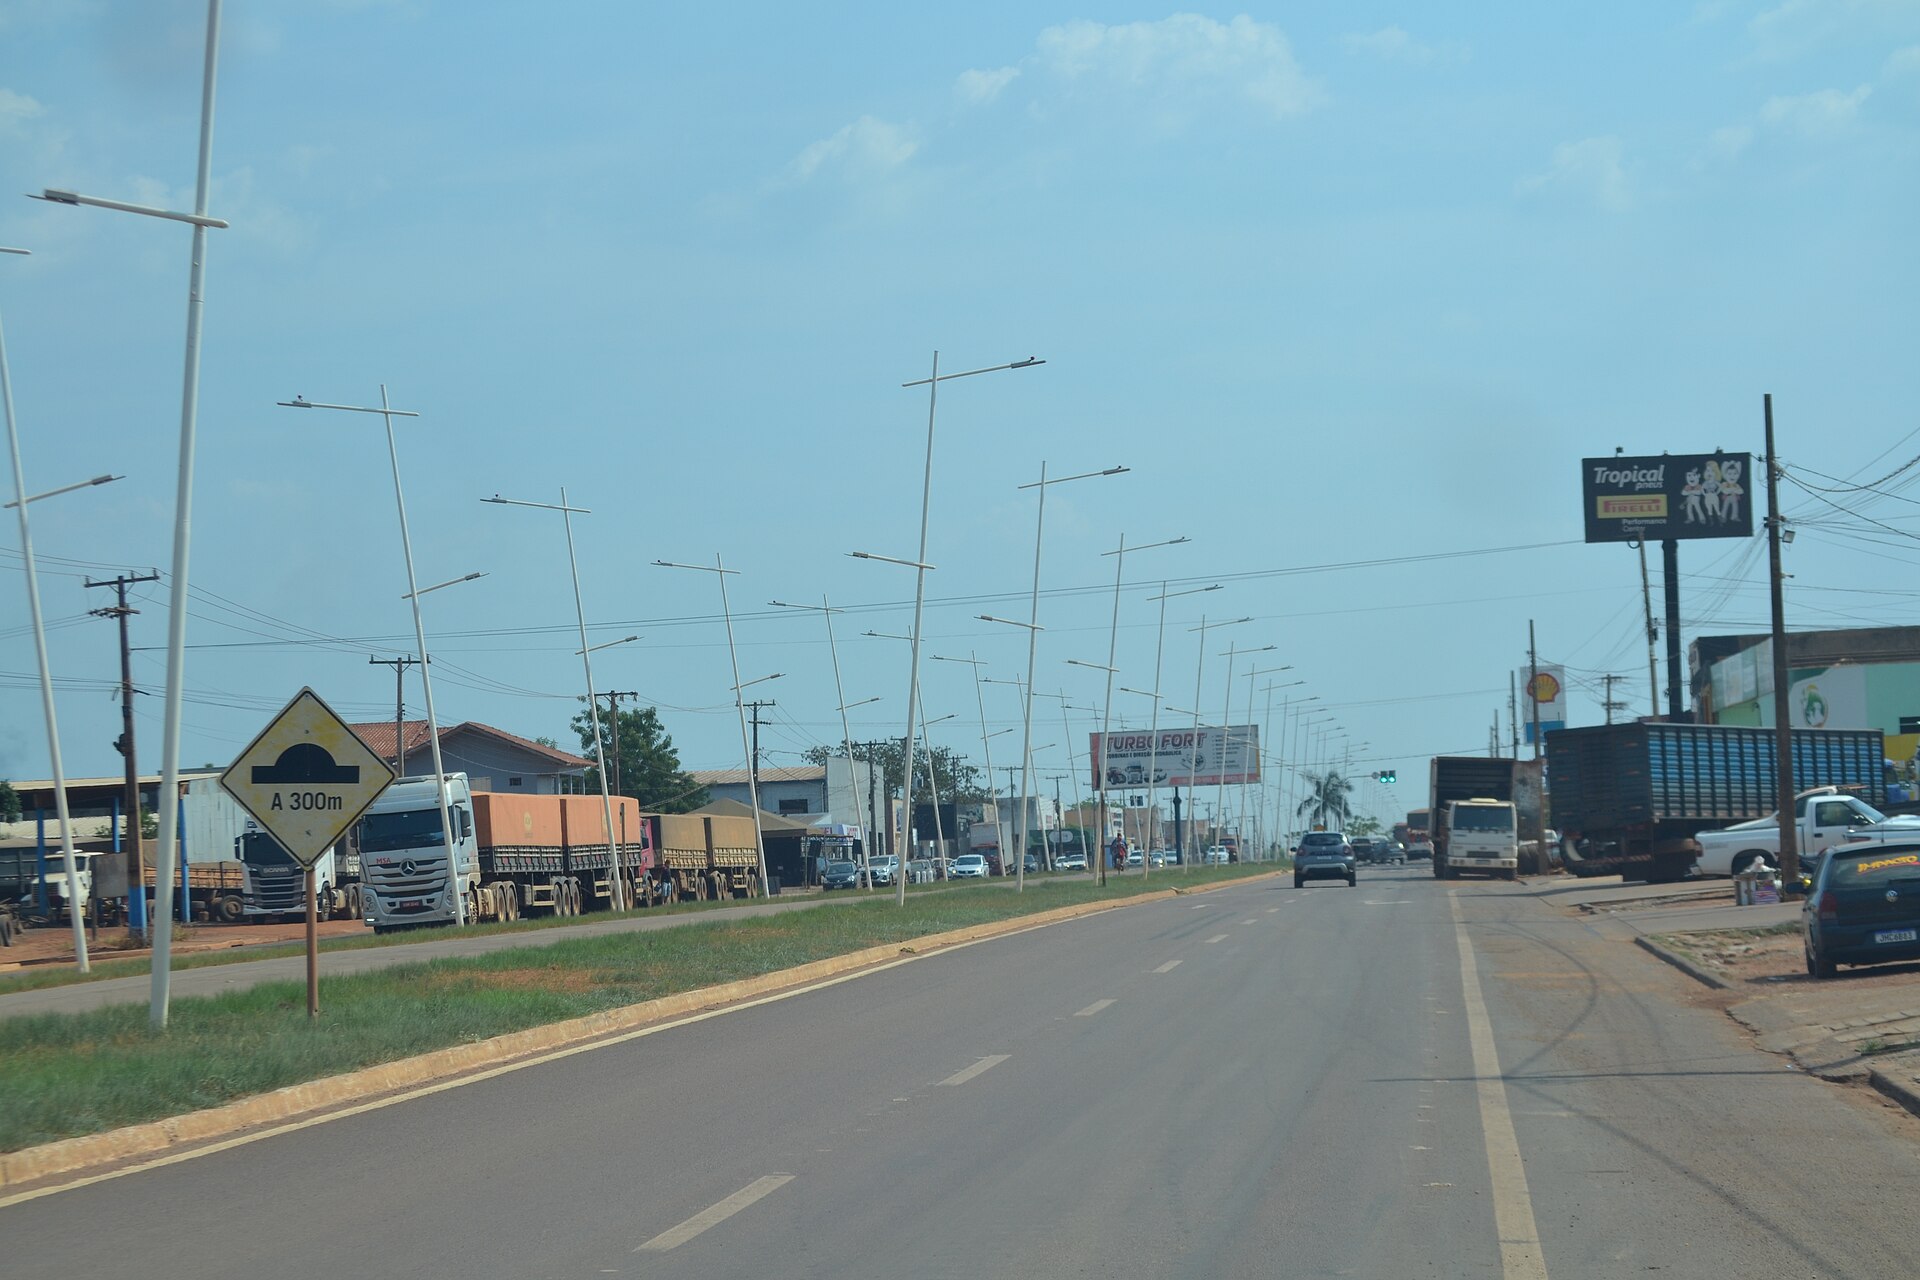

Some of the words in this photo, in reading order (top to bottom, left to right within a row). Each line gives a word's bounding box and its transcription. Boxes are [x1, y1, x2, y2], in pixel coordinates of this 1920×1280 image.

[1594, 464, 1665, 488] Tropical
[1635, 482, 1664, 491] pneus
[1604, 499, 1661, 512] PIRELLI
[1161, 732, 1207, 749] FORT
[271, 793, 283, 810] A
[290, 792, 343, 810] 300m
